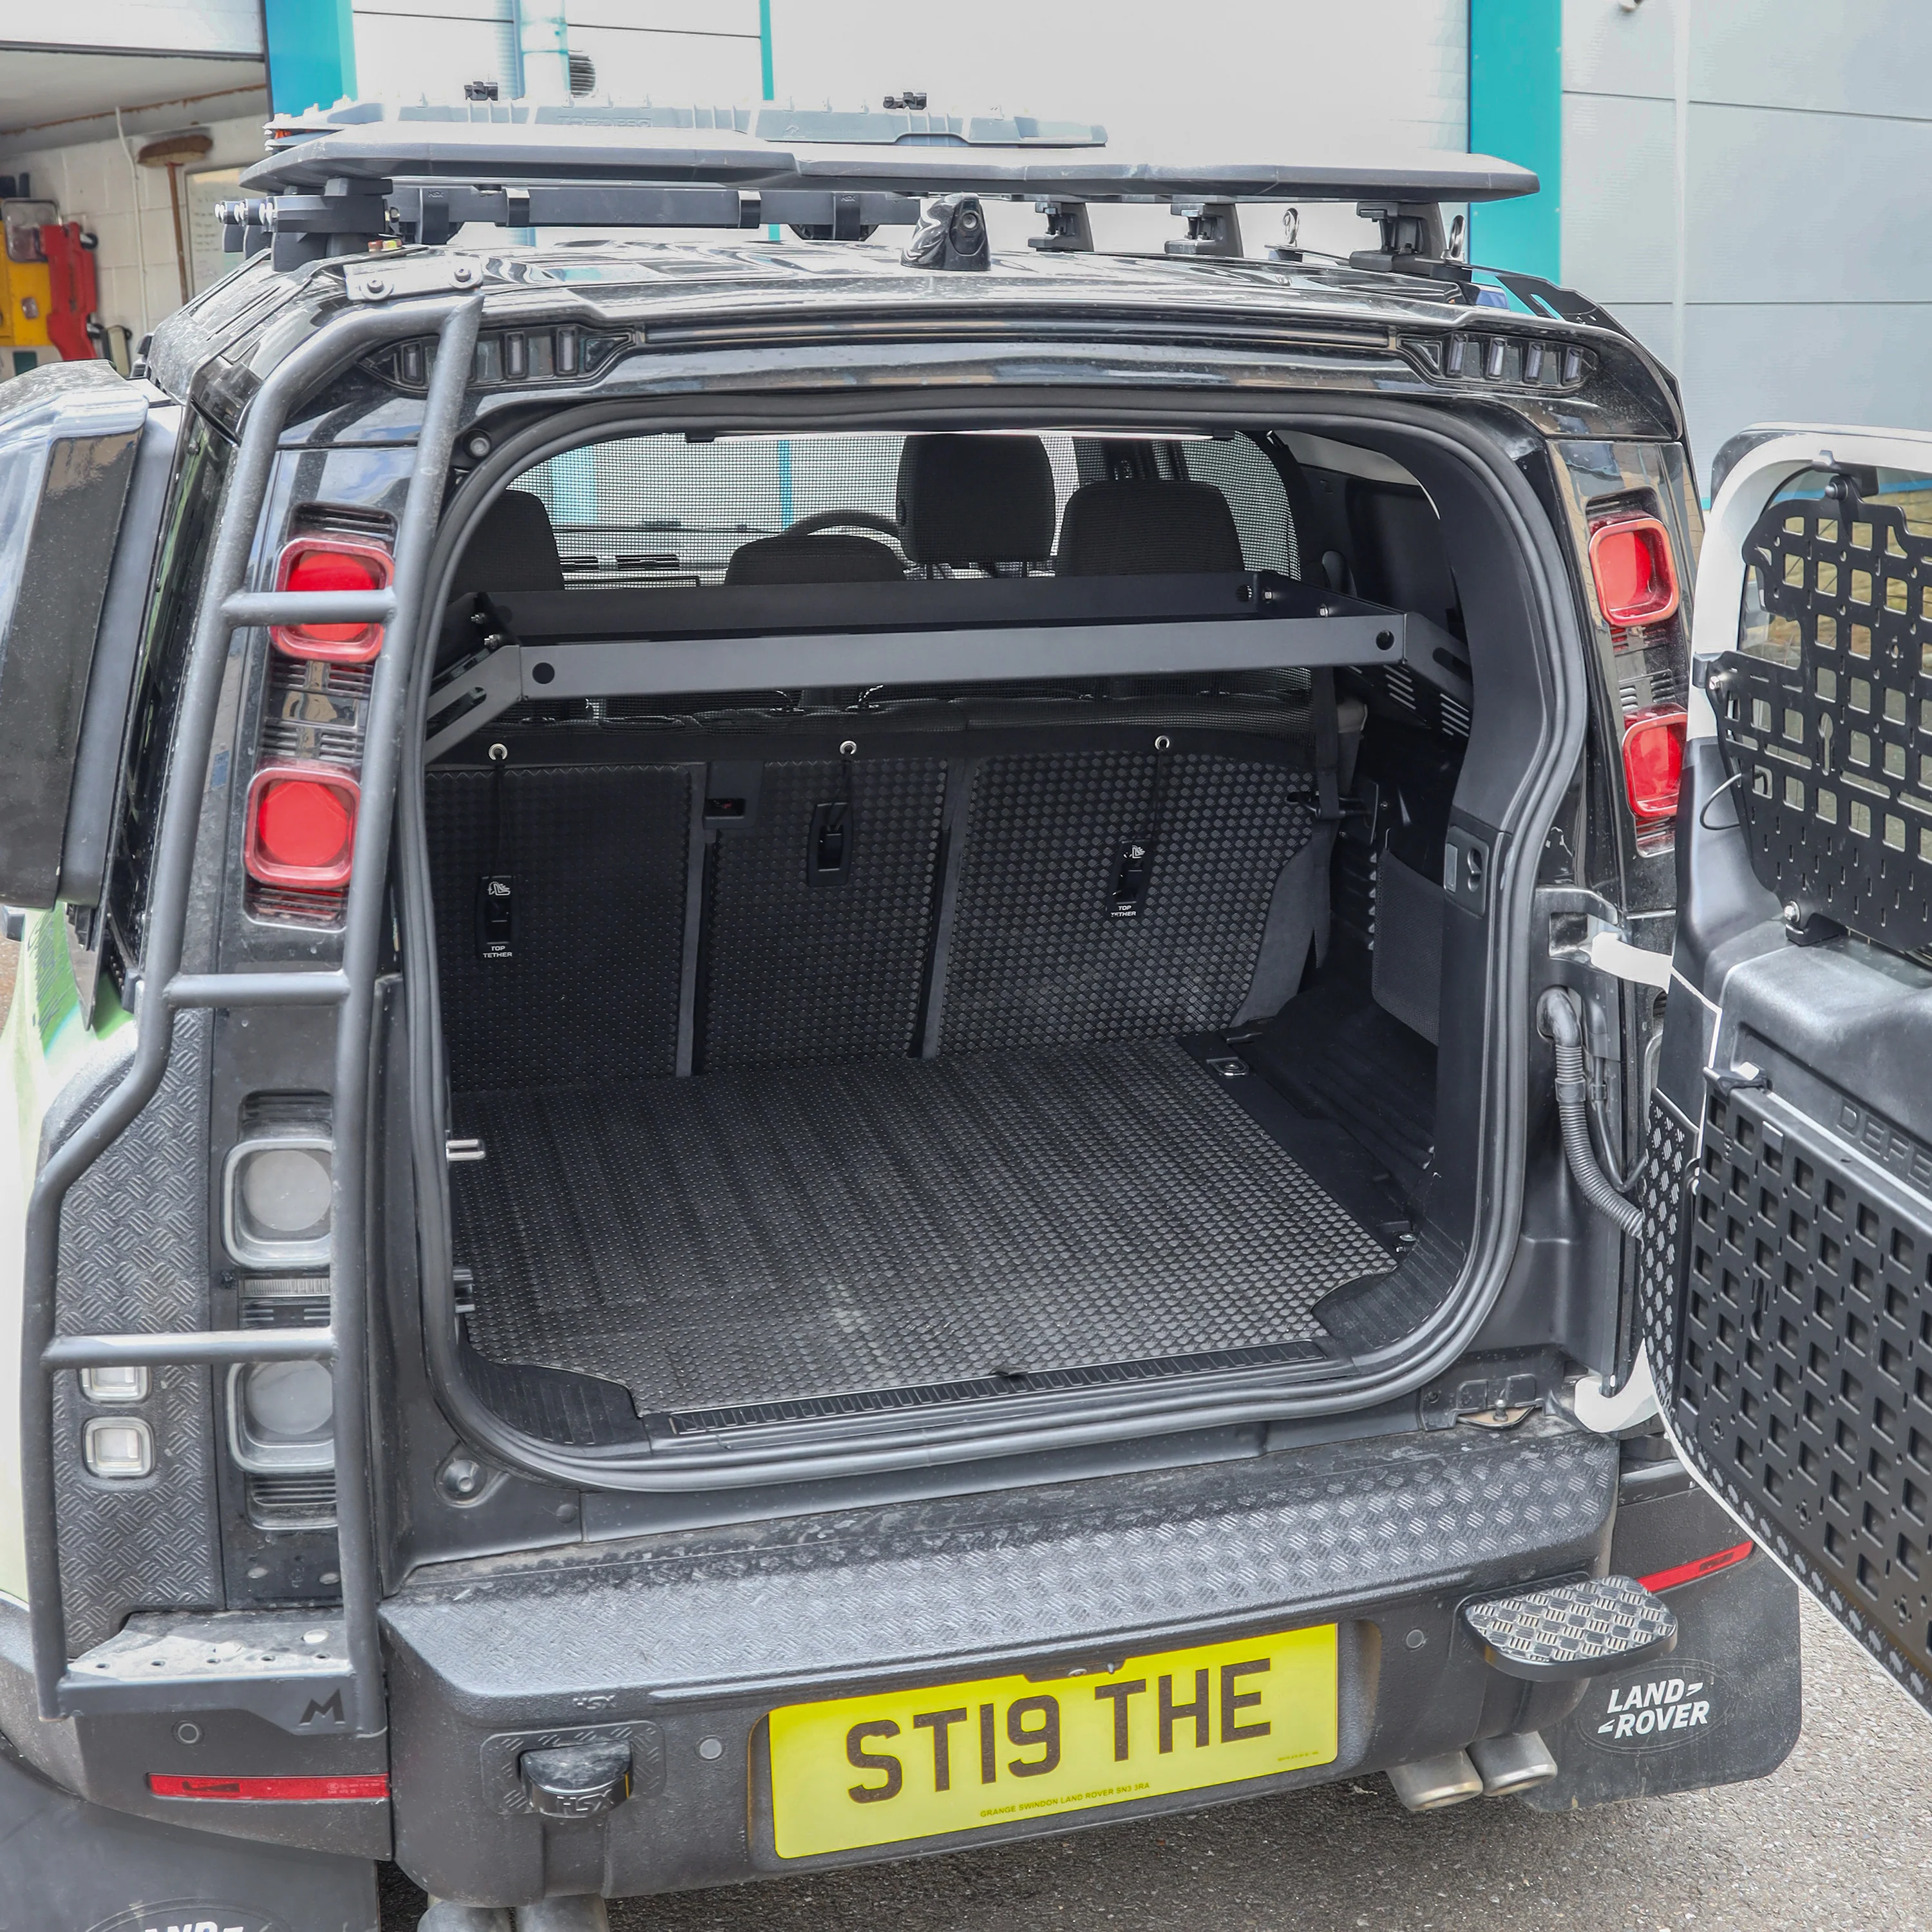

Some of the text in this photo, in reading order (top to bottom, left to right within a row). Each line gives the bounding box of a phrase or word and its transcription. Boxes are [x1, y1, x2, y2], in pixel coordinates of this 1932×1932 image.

[846, 1657, 1271, 1804] ST19 THE
[980, 1782, 1150, 1817] GRANGE SWINDON LAND ROVER SN3 3RA
